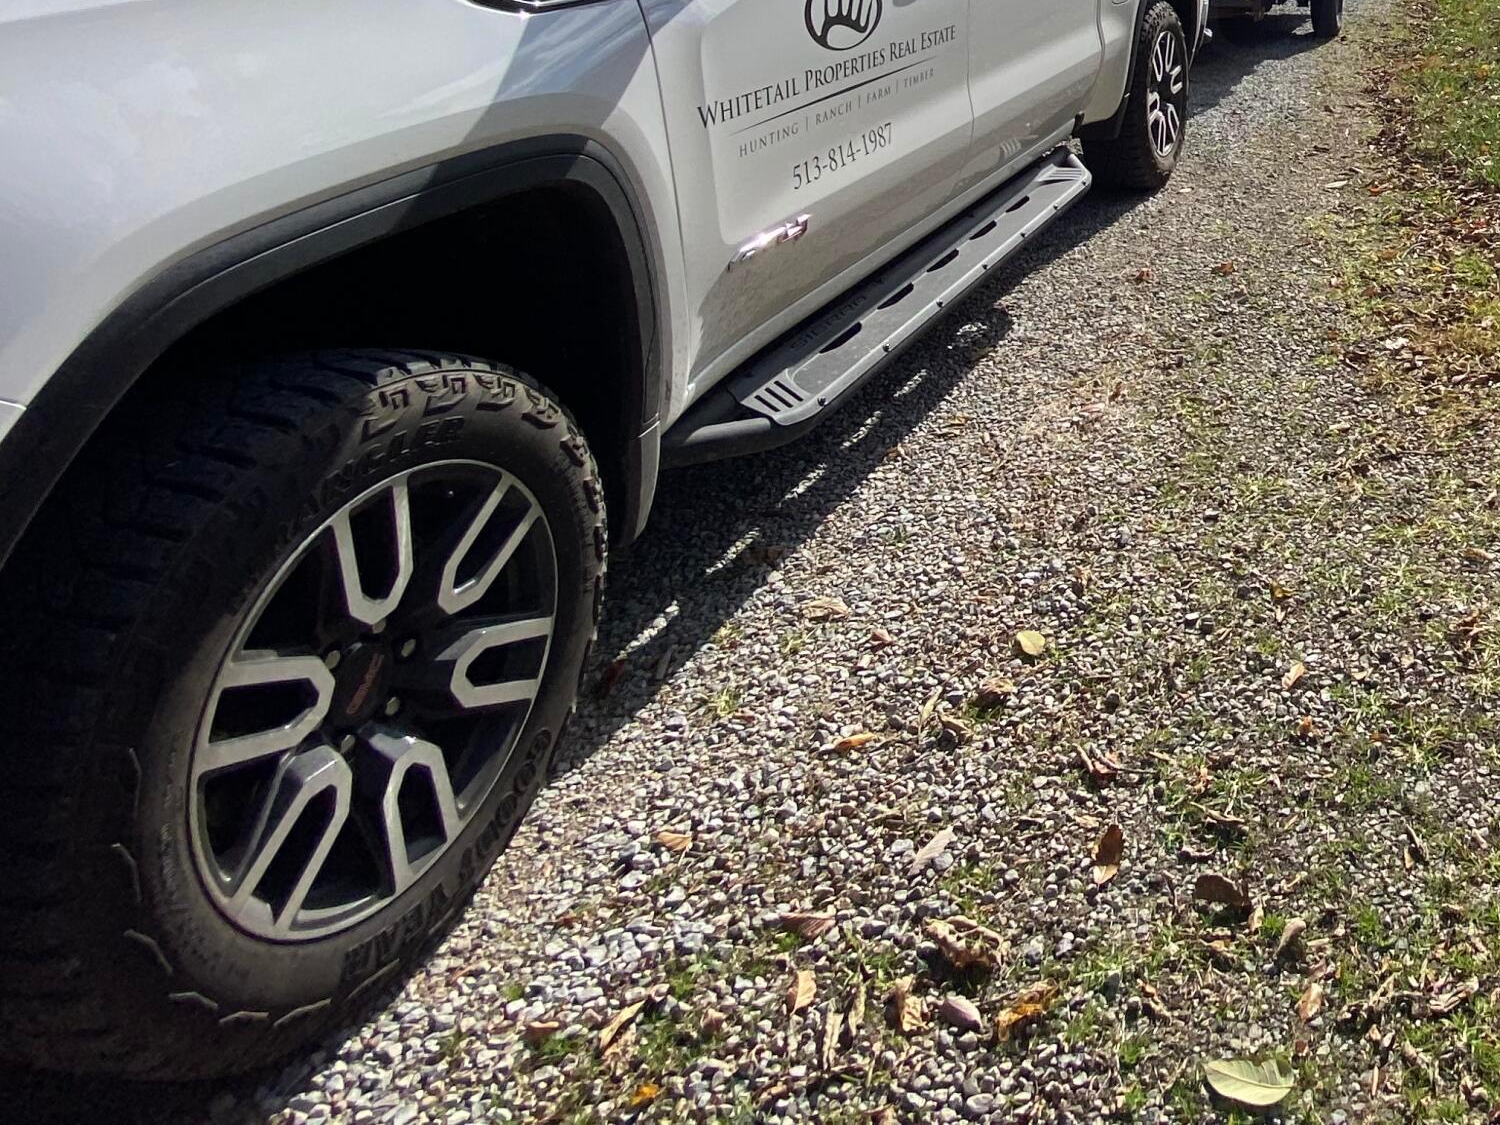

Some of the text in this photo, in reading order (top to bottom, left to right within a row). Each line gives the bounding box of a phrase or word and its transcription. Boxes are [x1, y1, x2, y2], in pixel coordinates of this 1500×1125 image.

[697, 25, 956, 129] WHITETAIL PROPERTIES REAL ESTATE
[739, 68, 934, 158] HUNTING RANCH FARM TIMBER
[793, 122, 893, 190] 513-814-1987
